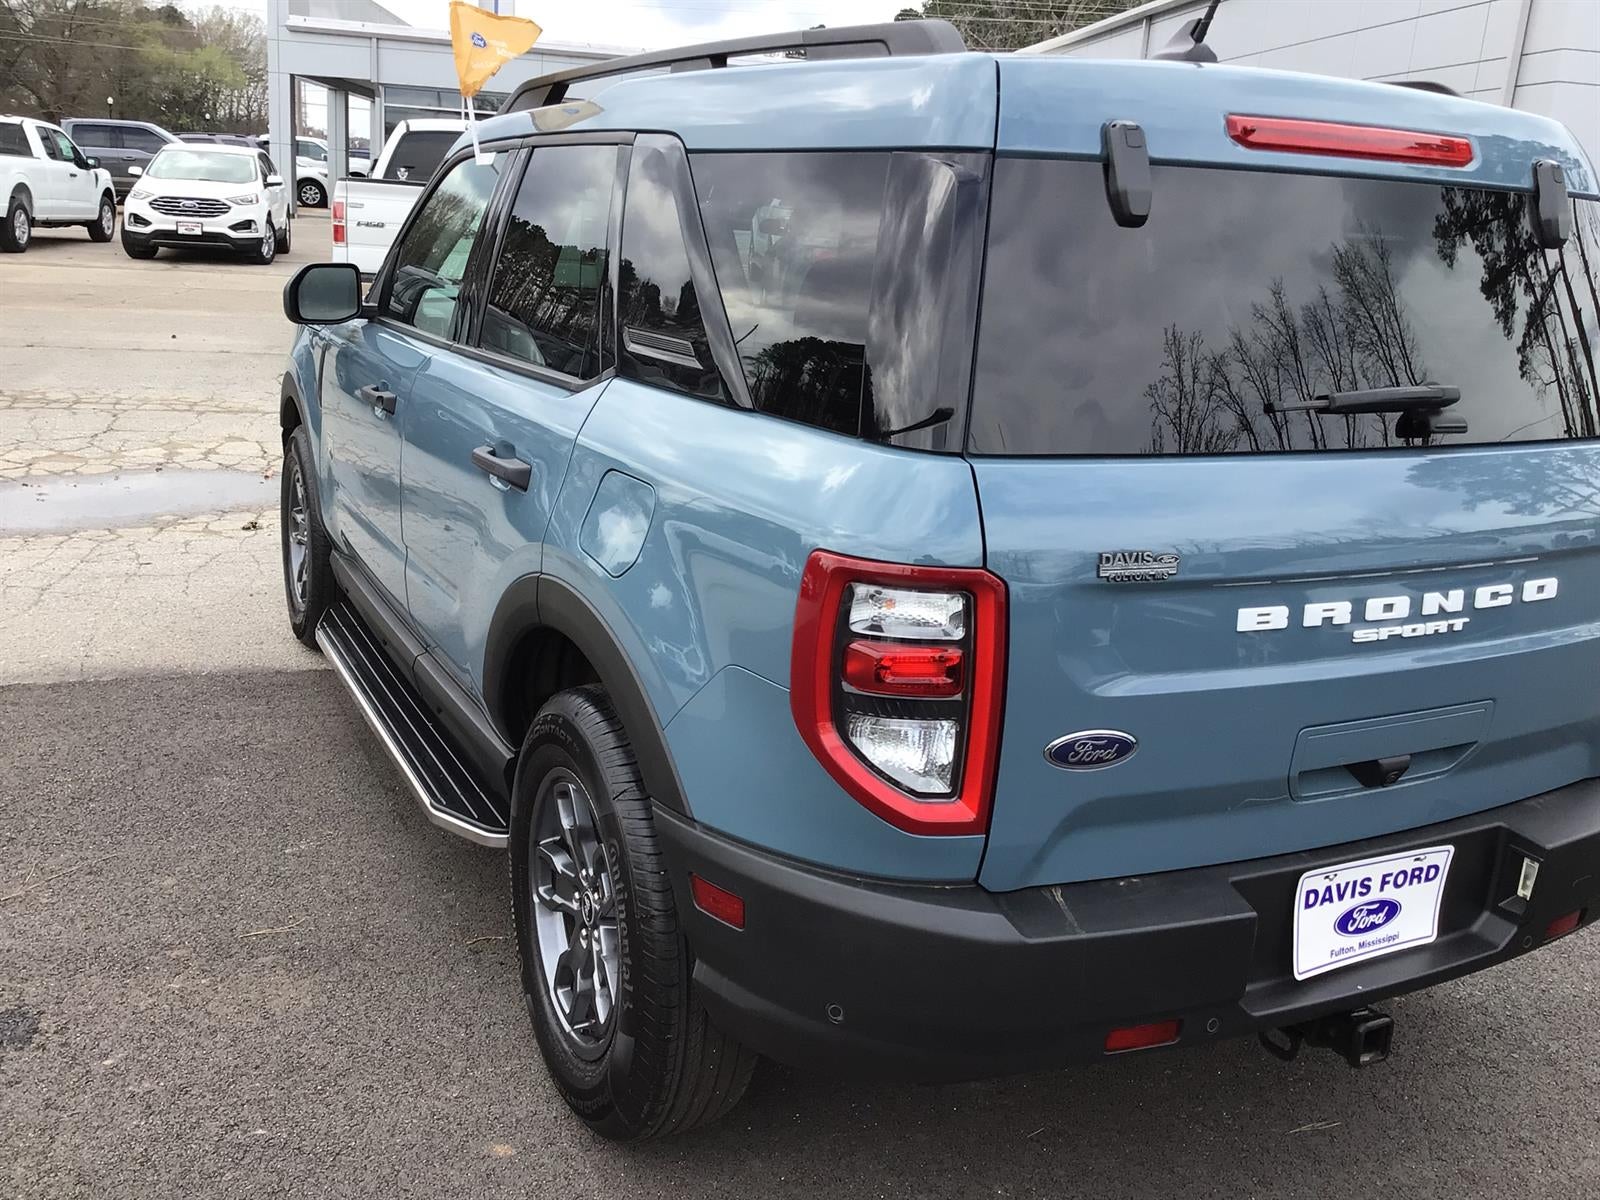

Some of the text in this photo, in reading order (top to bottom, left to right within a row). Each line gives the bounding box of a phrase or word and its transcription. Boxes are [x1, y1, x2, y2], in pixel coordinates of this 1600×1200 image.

[1101, 551, 1154, 567] DAVIS
[1236, 577, 1558, 632] BRONCO
[1352, 617, 1470, 642] SPORT
[1068, 739, 1120, 763] Ford
[1304, 863, 1440, 910] DAVIS FORD
[1347, 903, 1389, 932] Ford
[1330, 931, 1401, 959] Fulton, Mississippi
